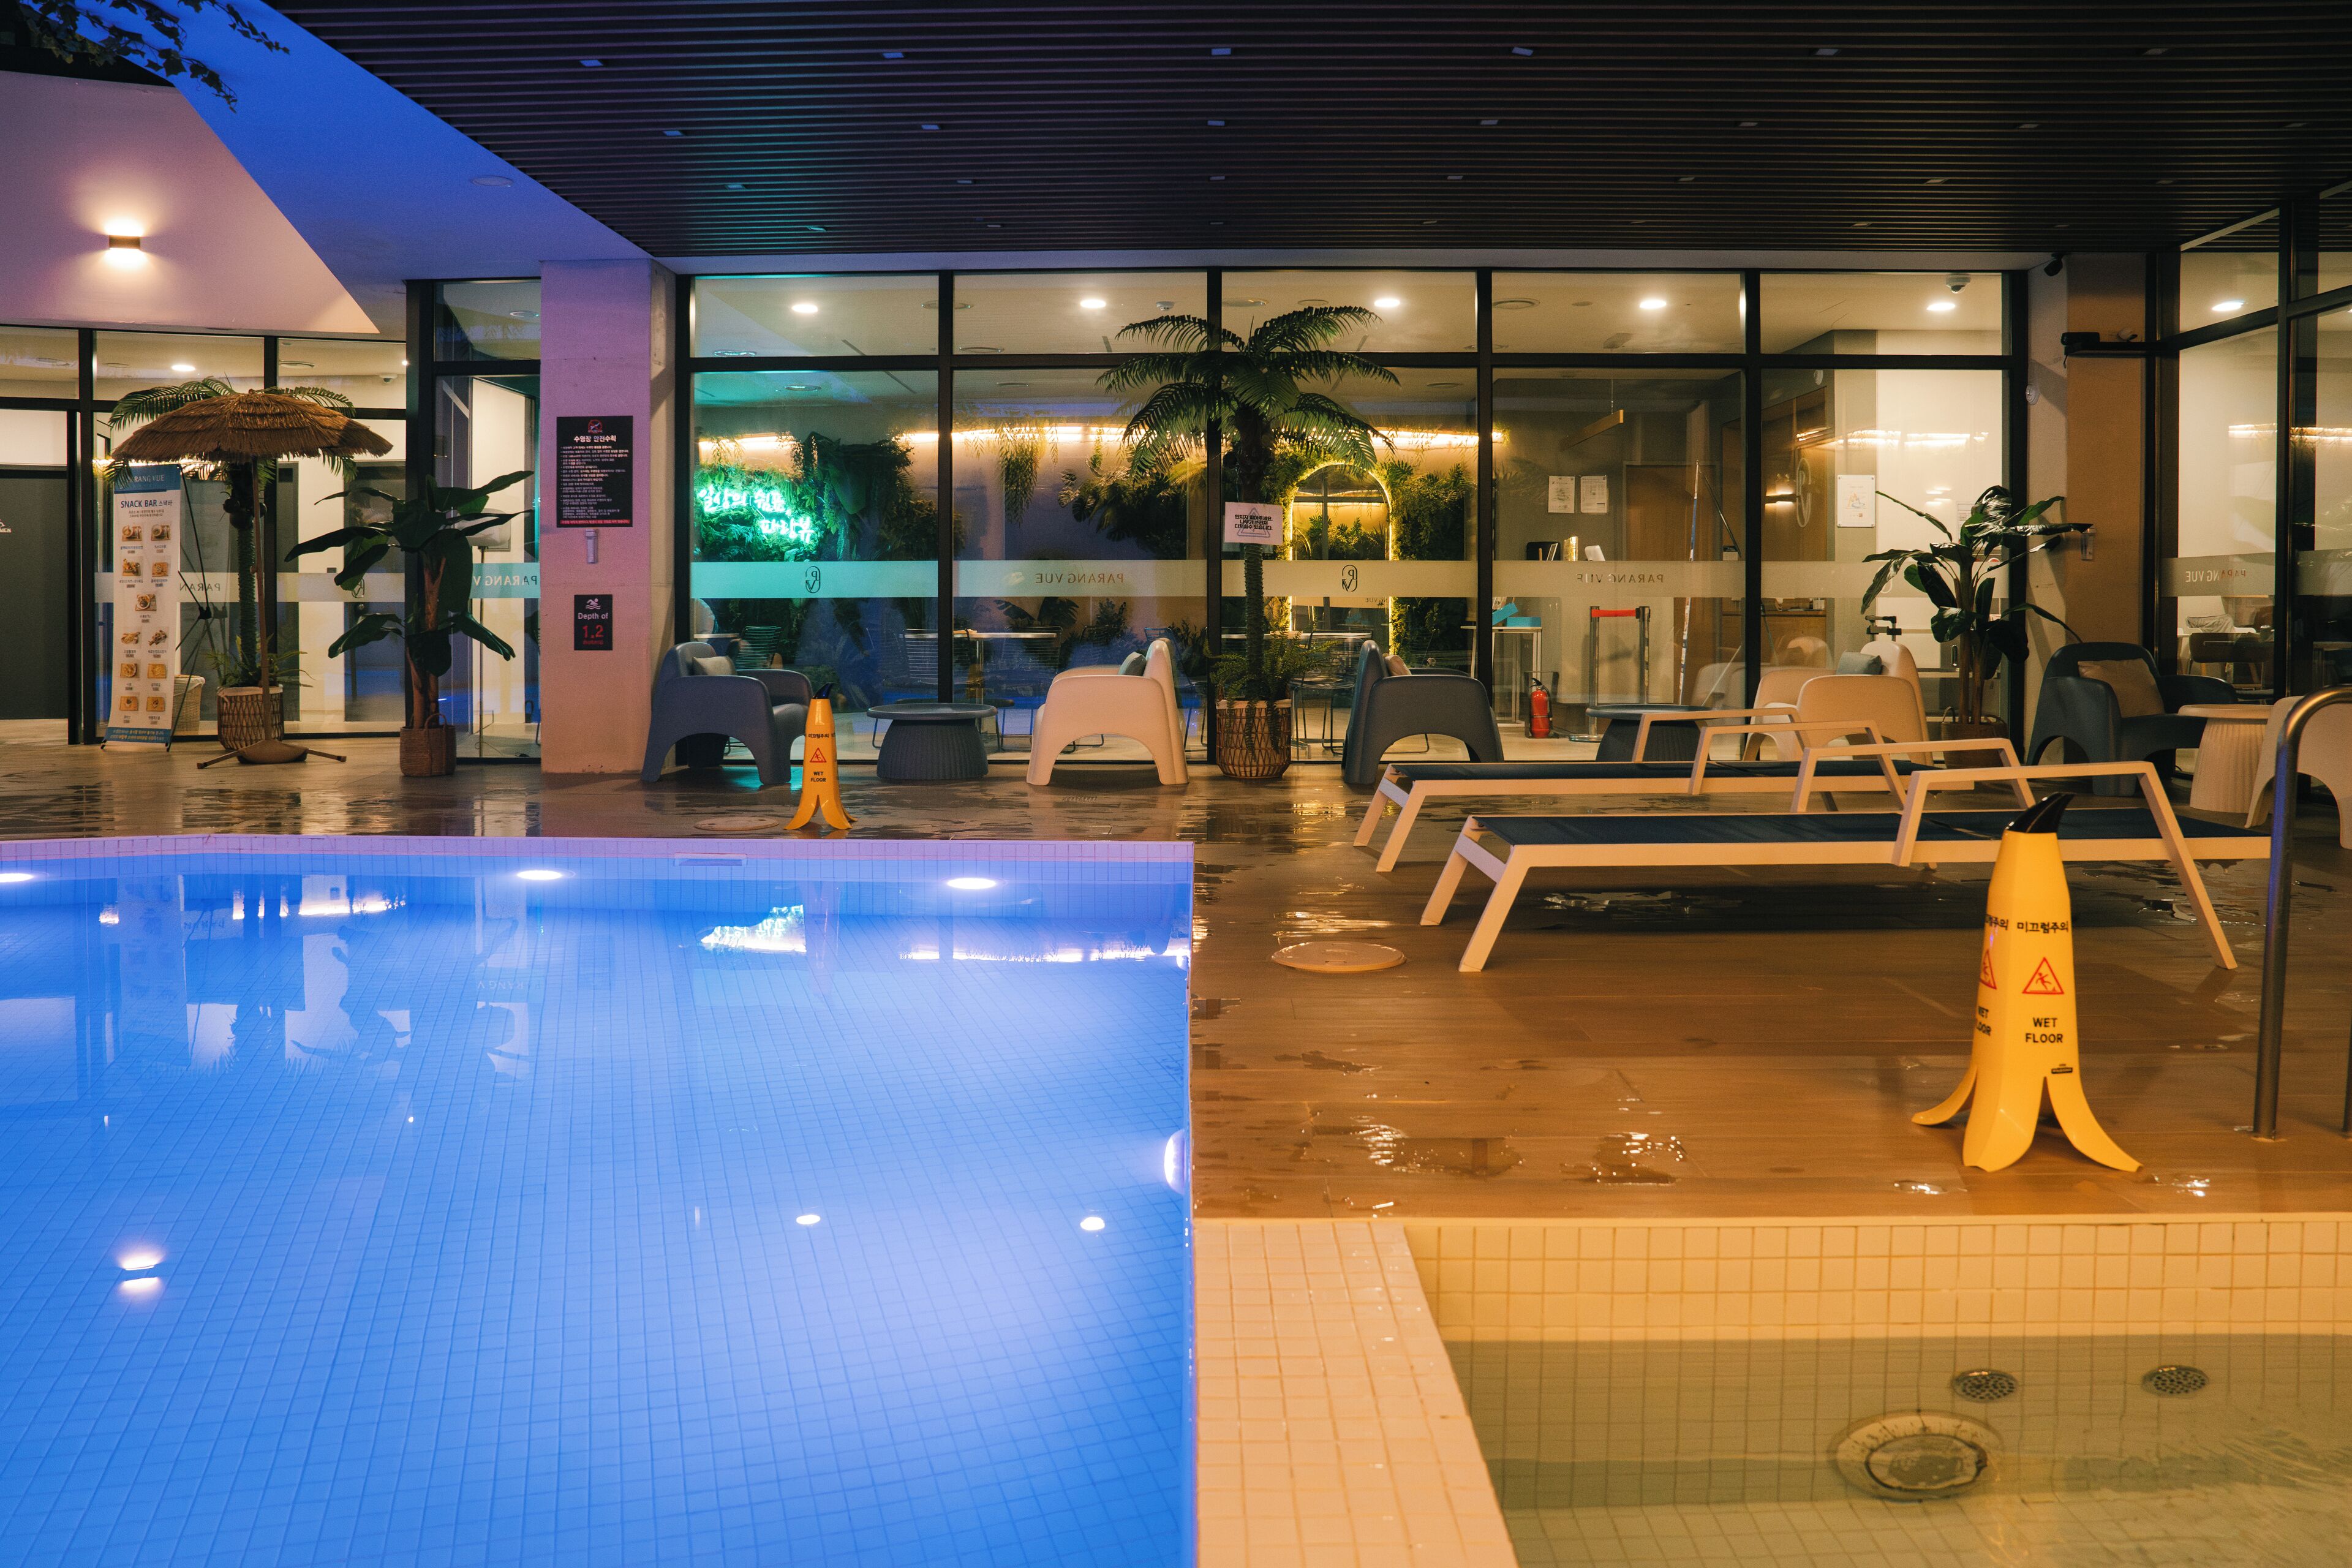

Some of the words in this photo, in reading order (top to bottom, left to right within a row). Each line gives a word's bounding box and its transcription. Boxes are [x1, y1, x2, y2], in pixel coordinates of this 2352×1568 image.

[699, 485, 748, 511] 일상의
[760, 517, 814, 543] 파랑뷰
[582, 625, 603, 638] 1.2
[2017, 921, 2068, 933] 미끄럼주의
[2032, 1017, 2058, 1028] WET
[2025, 1033, 2064, 1044] FLOOR
